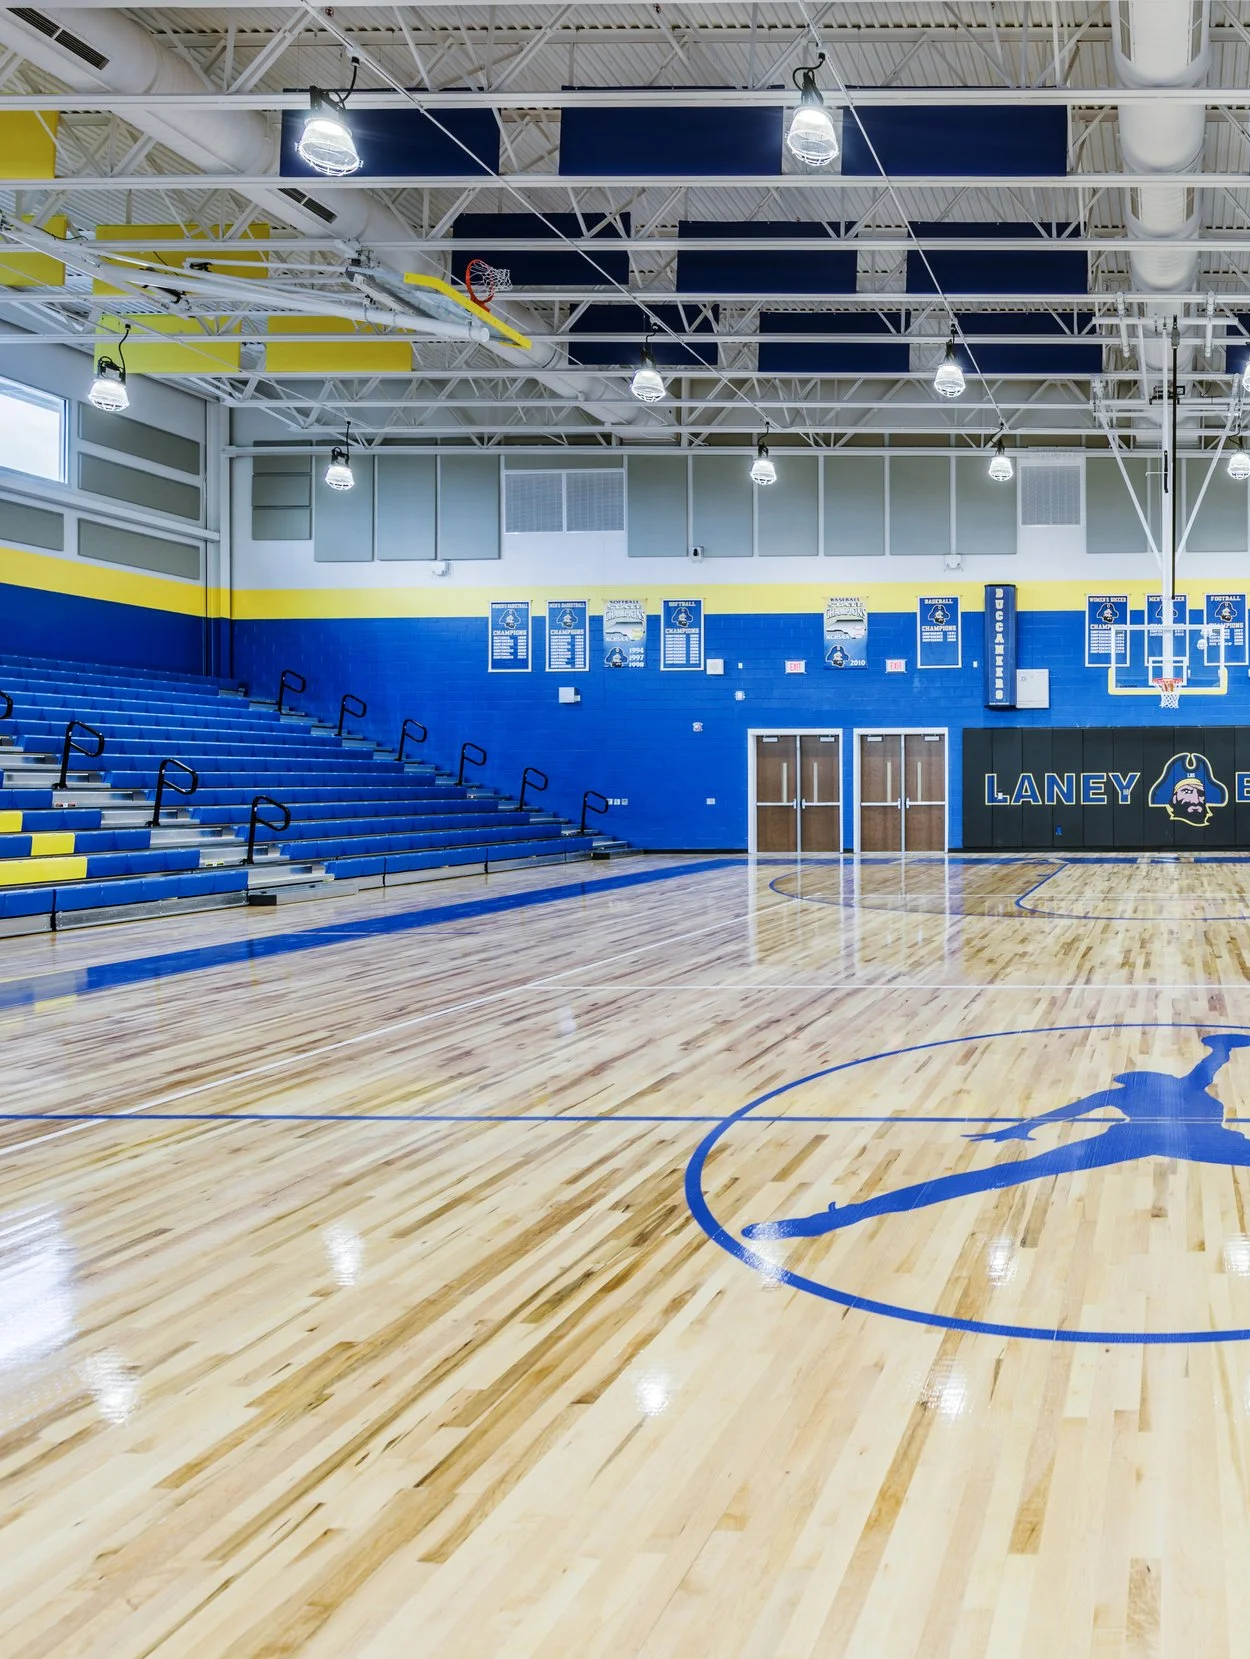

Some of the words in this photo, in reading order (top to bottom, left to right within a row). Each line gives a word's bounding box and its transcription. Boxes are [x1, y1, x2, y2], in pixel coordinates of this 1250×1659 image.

[826, 607, 866, 619] CHAMPIONS
[994, 588, 1004, 700] BUCCANEERS
[985, 772, 1140, 805] LANEY
